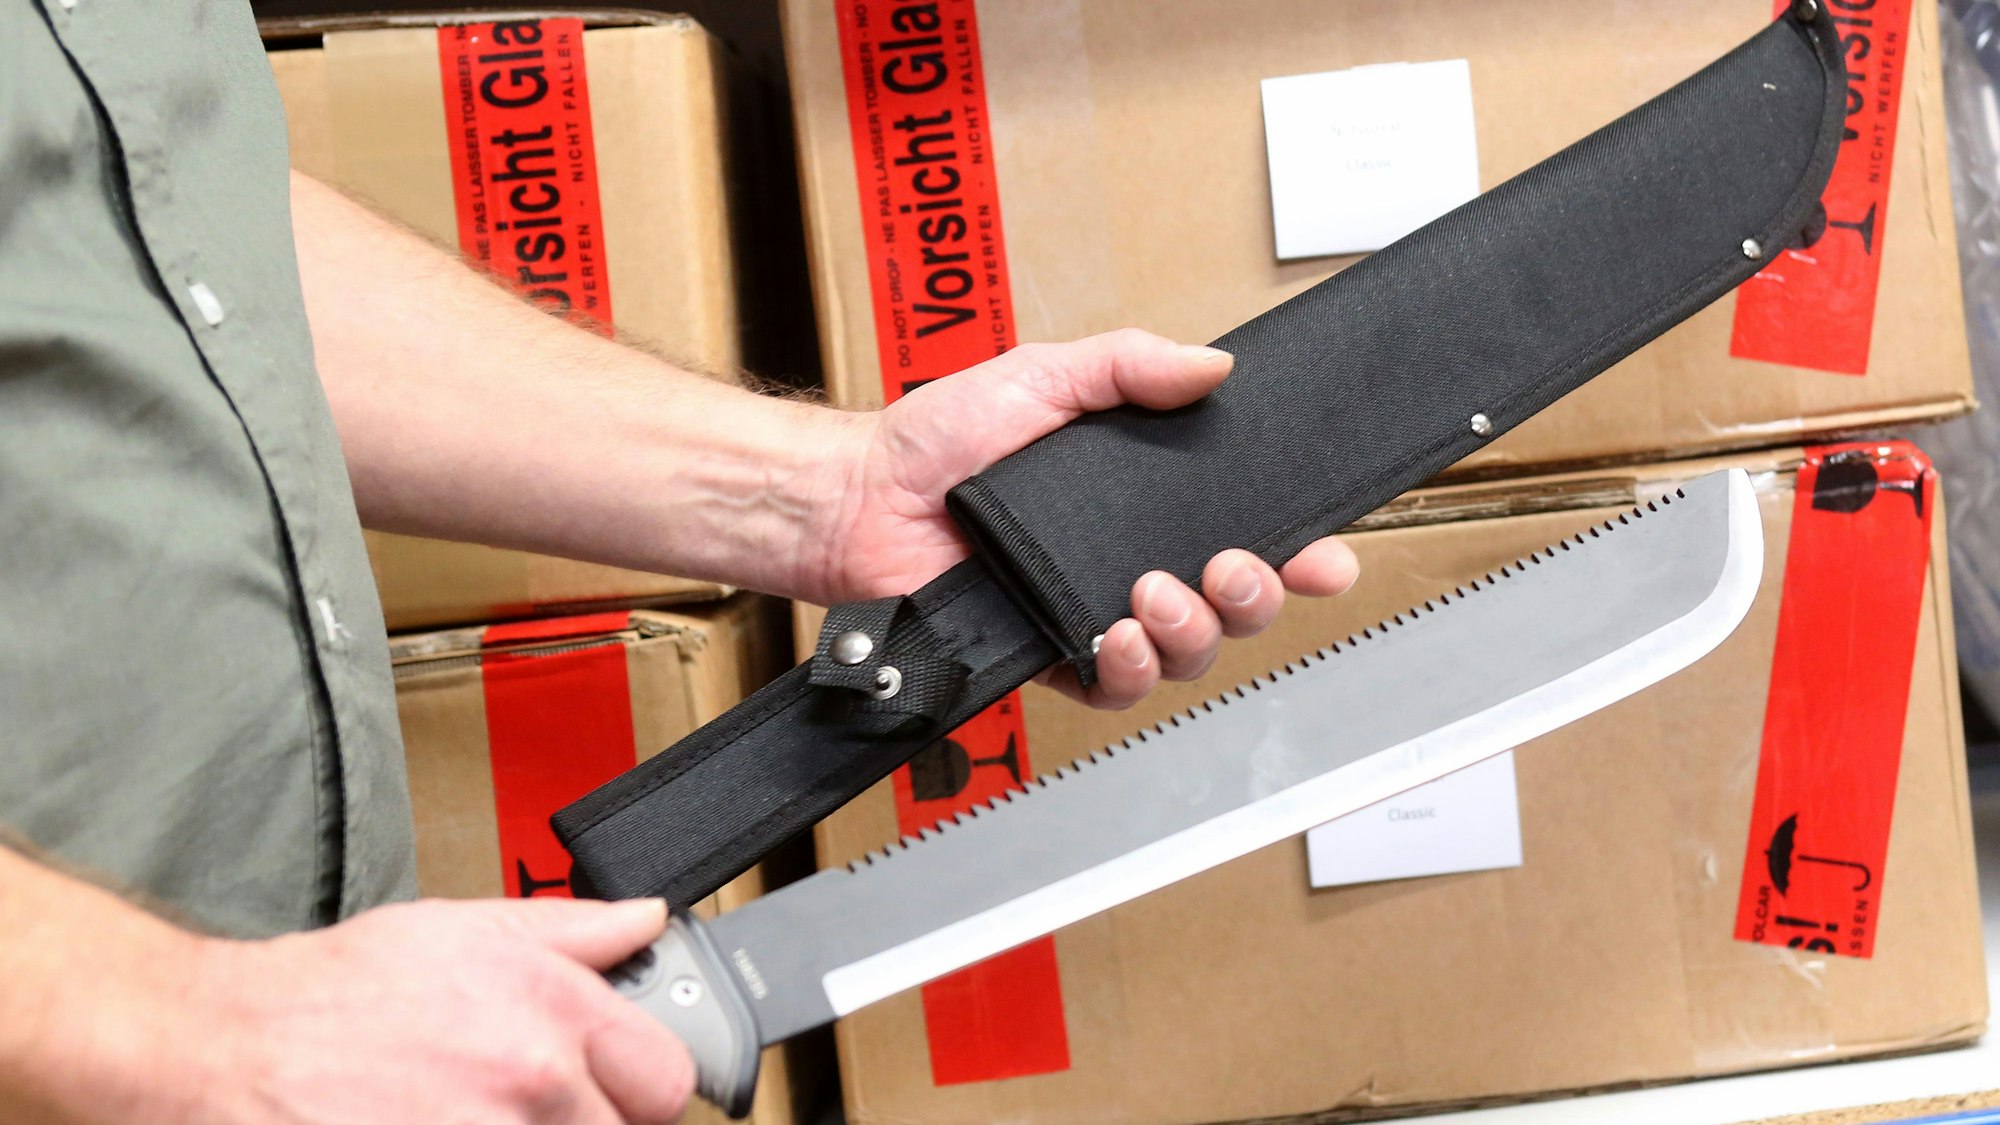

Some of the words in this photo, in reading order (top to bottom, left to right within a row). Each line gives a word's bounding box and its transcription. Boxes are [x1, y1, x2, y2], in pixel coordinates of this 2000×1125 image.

[853, 3, 869, 28] NO
[558, 33, 576, 110] FALLEN
[859, 42, 878, 109] TOMBER
[879, 0, 948, 94] Gla
[954, 18, 975, 95] FALLEN
[457, 54, 476, 124] TOMBER
[1868, 123, 1886, 183] NICHT
[1878, 31, 1898, 113] WERFEN
[465, 127, 485, 198] LAISSER
[566, 122, 585, 182] NICHT
[868, 113, 889, 182] LAISSER
[963, 105, 983, 164] NICHT
[472, 202, 488, 234] PAS
[490, 125, 572, 315] orsicht
[877, 186, 892, 216] PAS
[893, 110, 977, 339] Vorsicht
[476, 238, 492, 261] NE
[881, 221, 896, 243] NE
[978, 204, 999, 288] WERFEN
[577, 223, 597, 309] WERFEN
[886, 258, 903, 302] DROP
[893, 308, 907, 339] NOT
[988, 297, 1007, 355] NICHT
[897, 344, 912, 368] DO
[1387, 806, 1436, 822] Classic
[1751, 885, 1771, 944] OLCAR
[1850, 899, 1868, 958] SSEN
